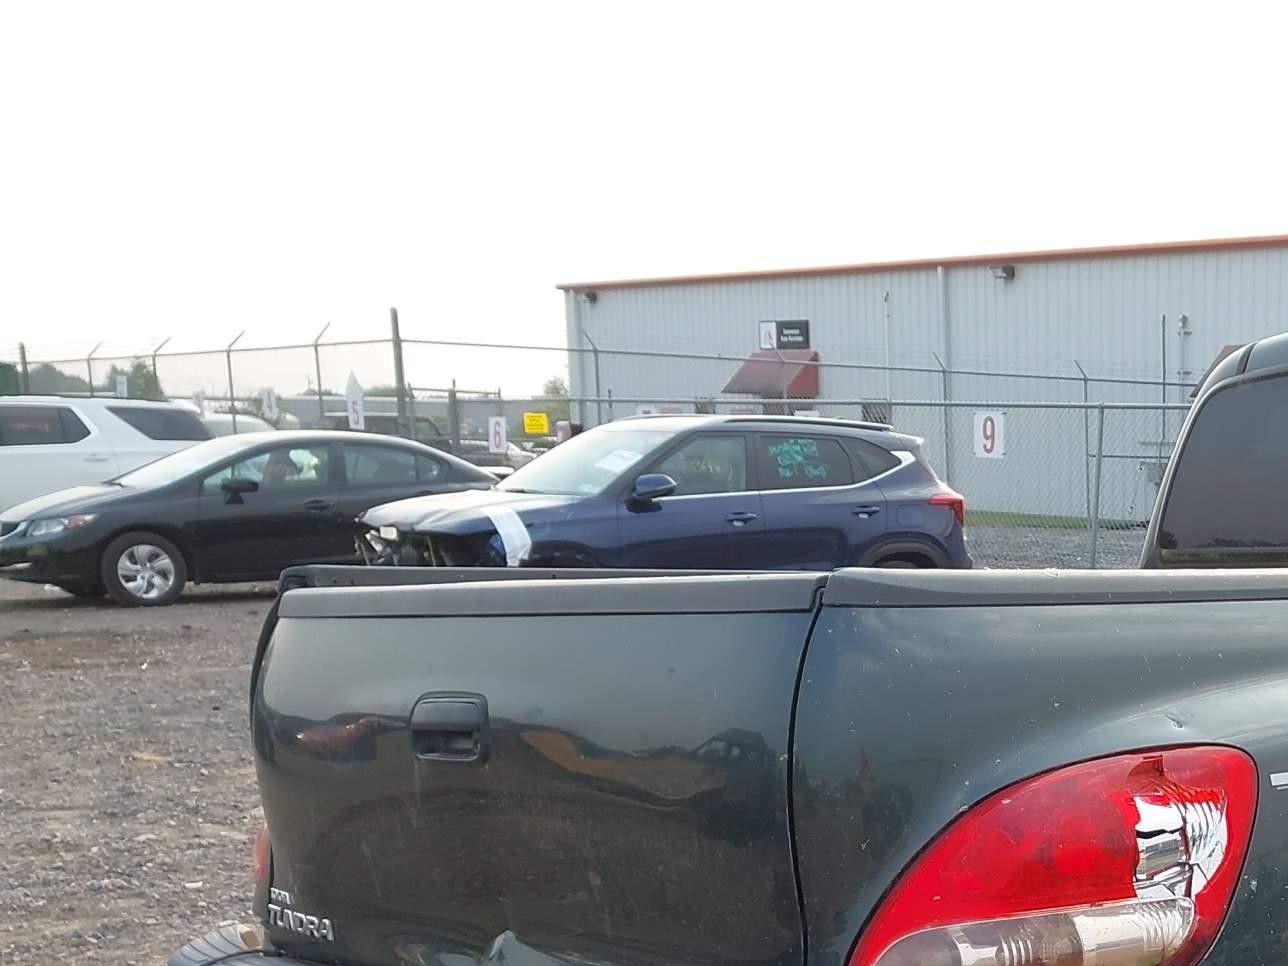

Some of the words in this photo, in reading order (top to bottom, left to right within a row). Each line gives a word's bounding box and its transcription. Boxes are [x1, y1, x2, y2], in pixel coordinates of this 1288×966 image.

[351, 400, 360, 426] 5
[494, 421, 502, 448] 6
[983, 416, 995, 453] 9
[268, 904, 334, 940] TUNDRA
